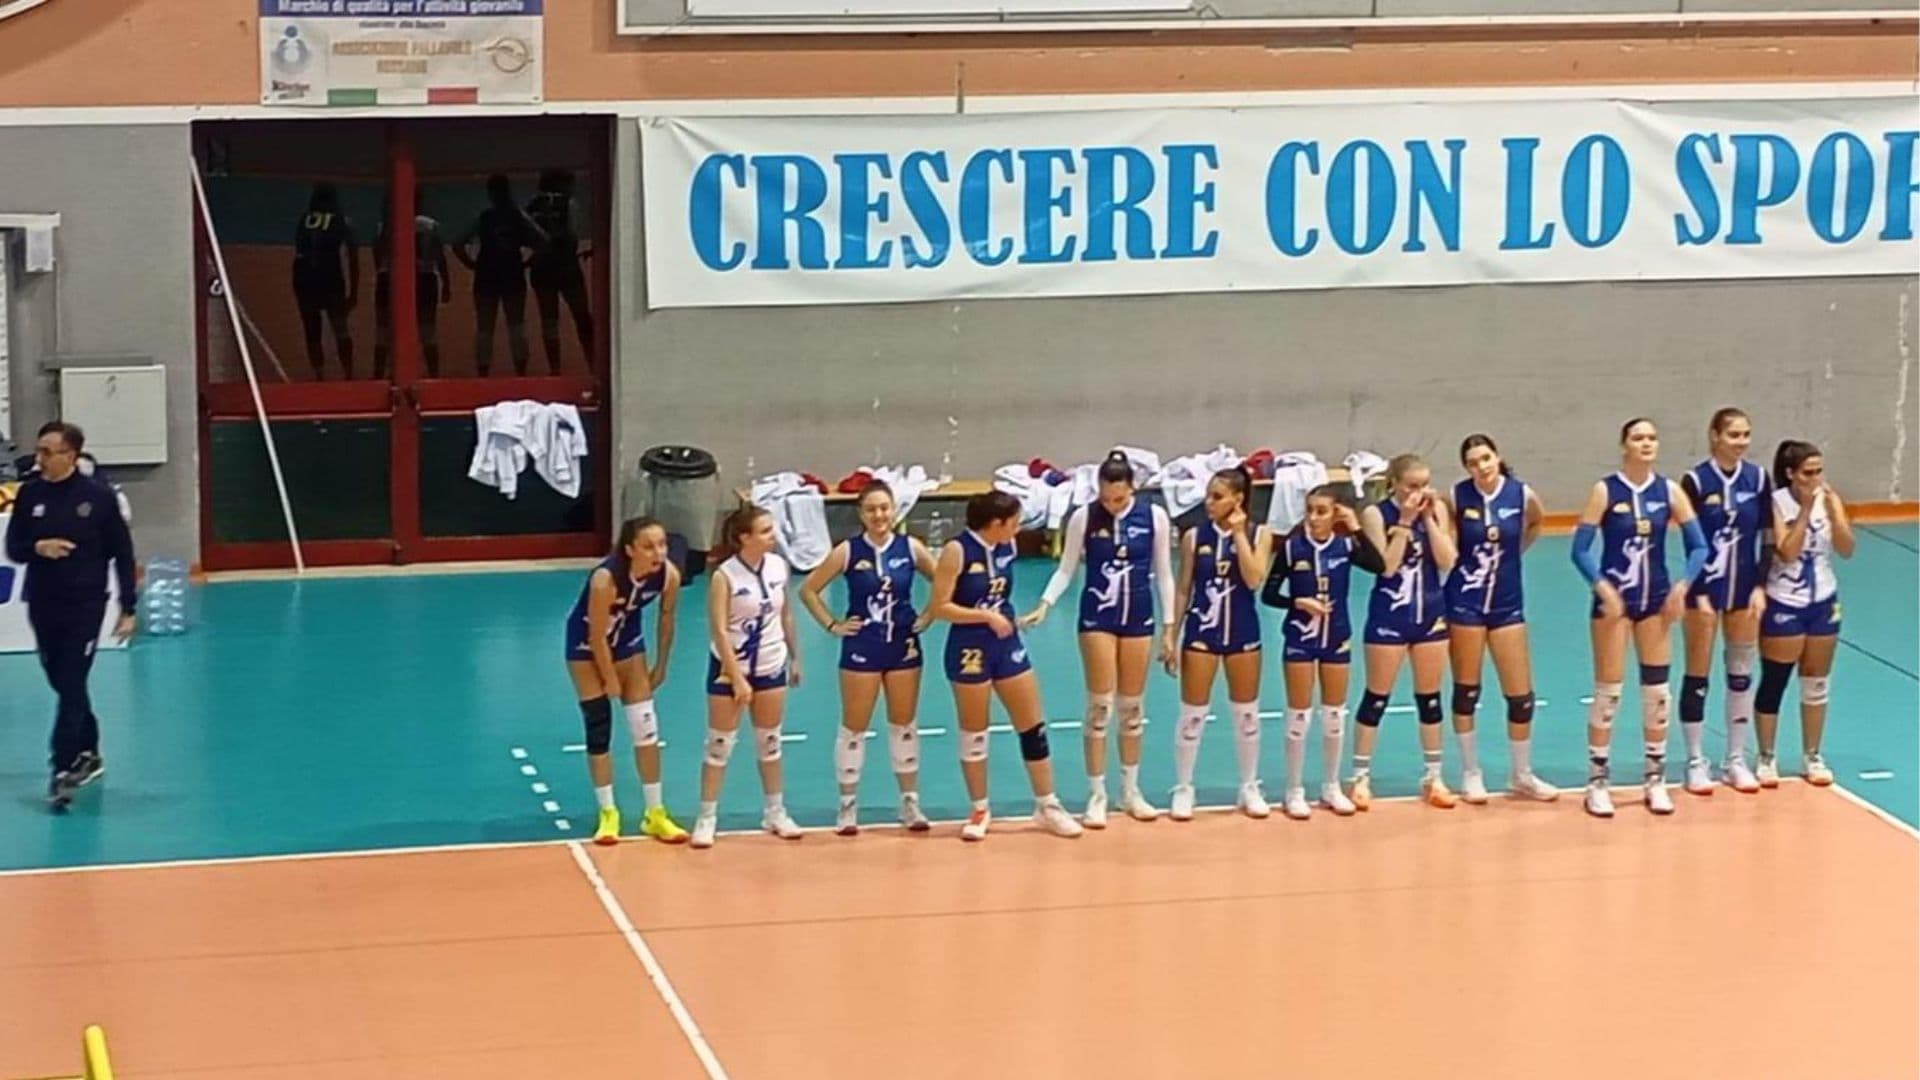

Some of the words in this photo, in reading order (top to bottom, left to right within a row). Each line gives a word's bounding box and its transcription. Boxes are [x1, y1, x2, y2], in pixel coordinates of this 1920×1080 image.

[392, 0, 413, 16] per
[689, 145, 1218, 271] CRESCERE
[1265, 140, 1466, 256] CON
[1500, 135, 1631, 249] LO
[881, 576, 892, 591] 2
